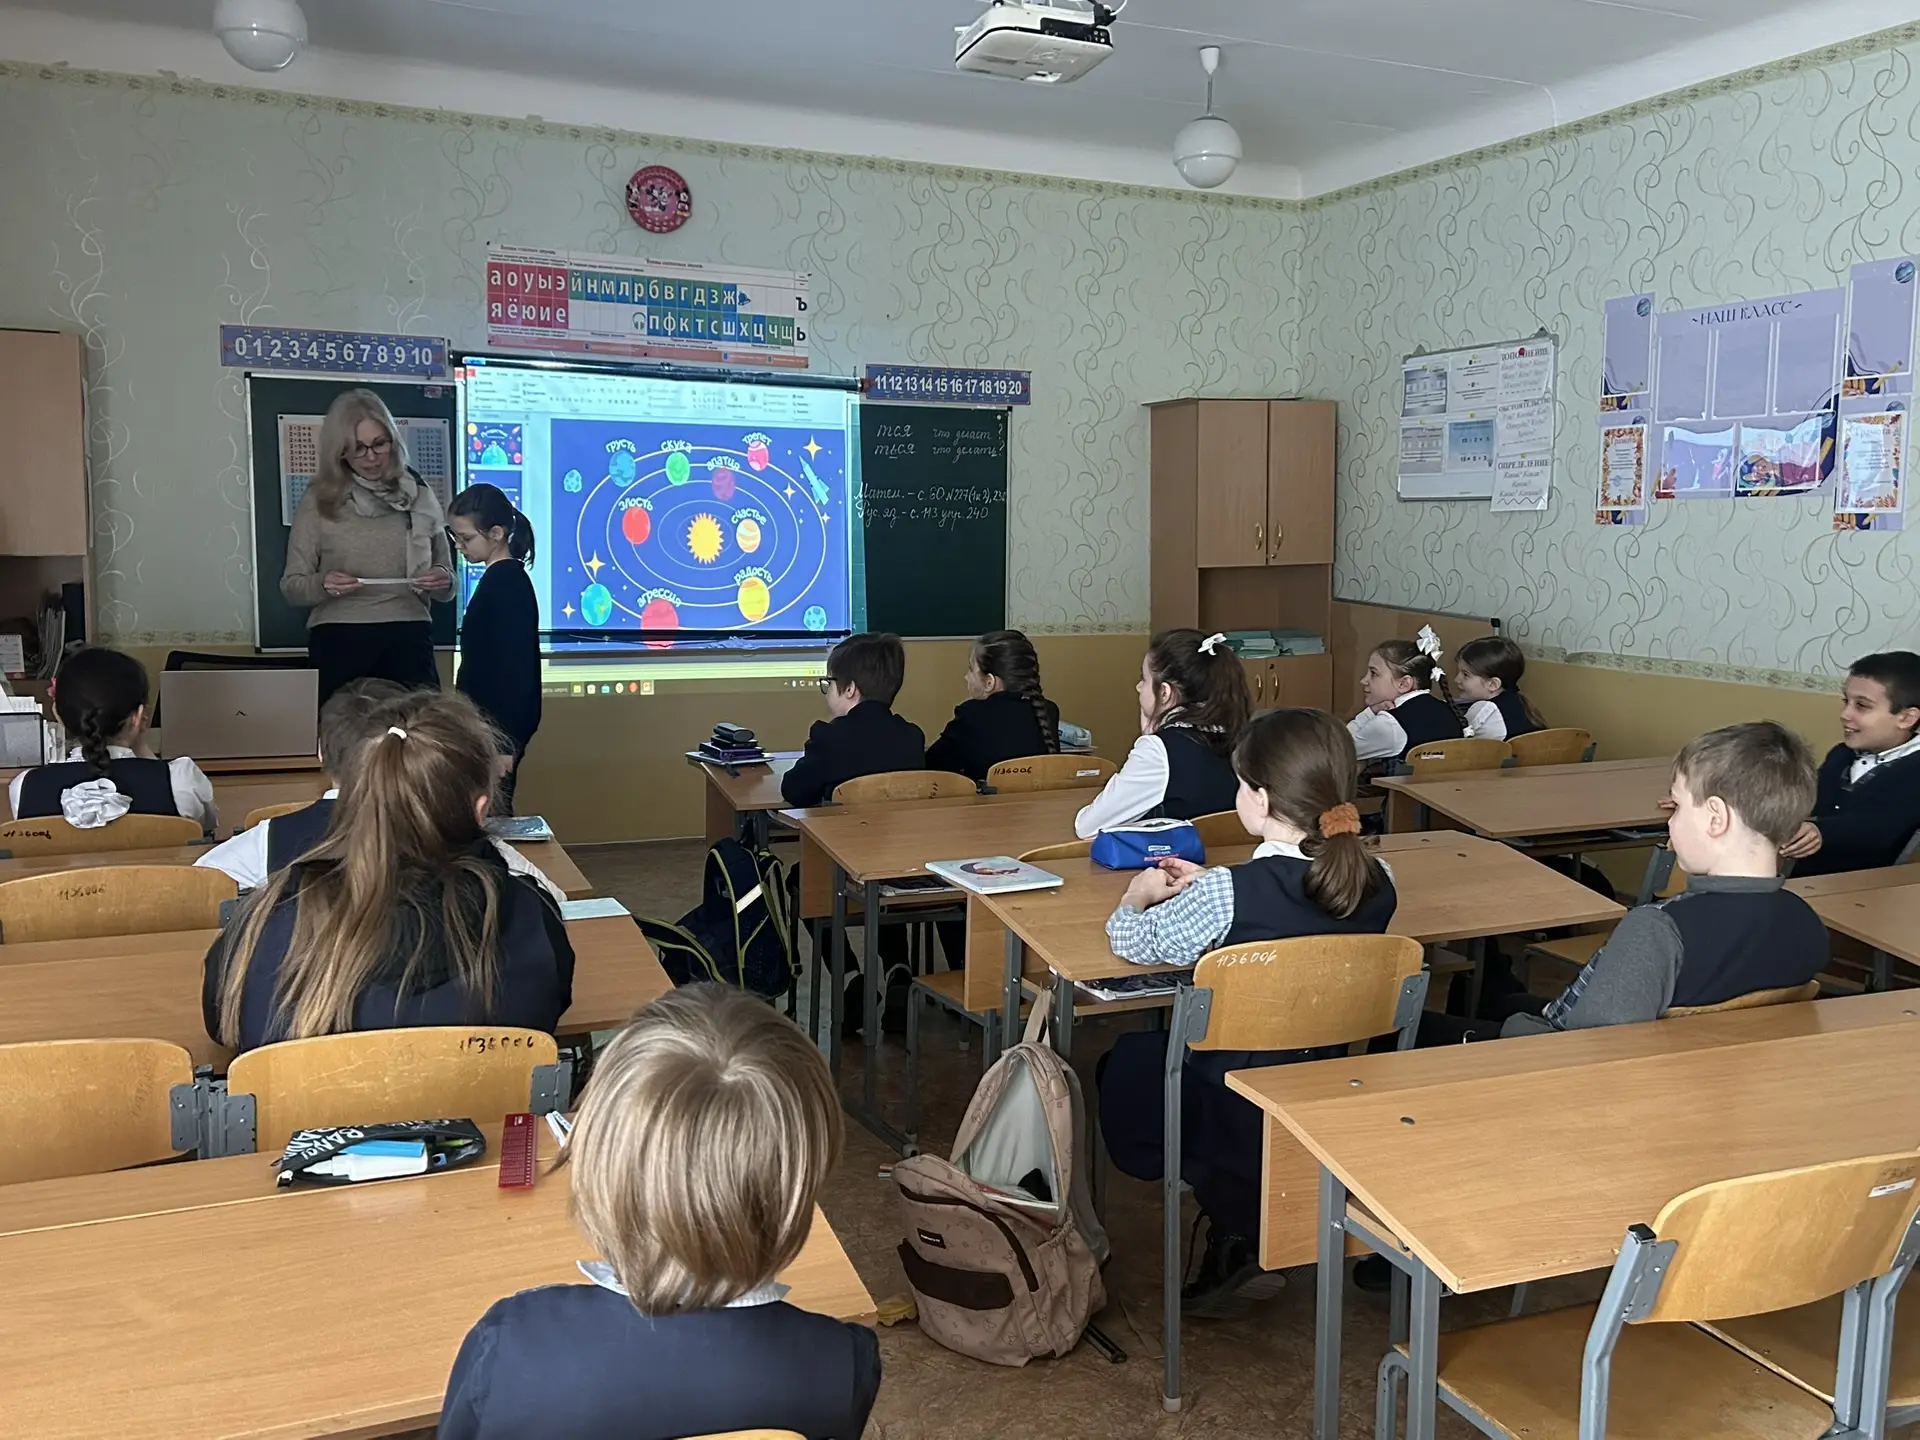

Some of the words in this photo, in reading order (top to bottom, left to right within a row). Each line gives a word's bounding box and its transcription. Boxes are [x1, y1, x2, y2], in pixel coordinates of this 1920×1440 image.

[1701, 308, 1736, 325] НАШ
[1740, 300, 1793, 320] КЛАСС
[235, 337, 246, 356] 0
[253, 338, 262, 357] 1
[270, 339, 282, 358] 2
[289, 340, 300, 358] 3
[307, 341, 319, 360] 4
[326, 342, 337, 360] 5
[343, 343, 354, 361] 6
[360, 344, 371, 362] 7
[377, 345, 388, 363] 8
[394, 346, 405, 364] 9
[411, 347, 432, 366] 10
[875, 375, 887, 390] 11
[889, 376, 902, 391] 12
[905, 377, 917, 391] 13
[920, 377, 932, 392] 14
[935, 378, 948, 393] 15
[950, 378, 962, 393] 16
[965, 379, 977, 394] 17
[979, 380, 992, 394] 18
[994, 380, 1006, 395] 19
[1009, 381, 1022, 395] 20
[742, 432, 773, 446] трепет
[876, 424, 914, 437] тся
[932, 428, 951, 438] что
[605, 439, 637, 453] грусть
[661, 439, 692, 452] скука
[874, 443, 916, 458] ться
[932, 446, 951, 454] что
[707, 455, 740, 472] апатия
[618, 497, 654, 512] злость
[731, 508, 767, 525] счастье
[734, 566, 773, 584] радость
[637, 587, 682, 608] агрессия
[994, 766, 1033, 775] 1136006
[1216, 949, 1278, 968] 1136006
